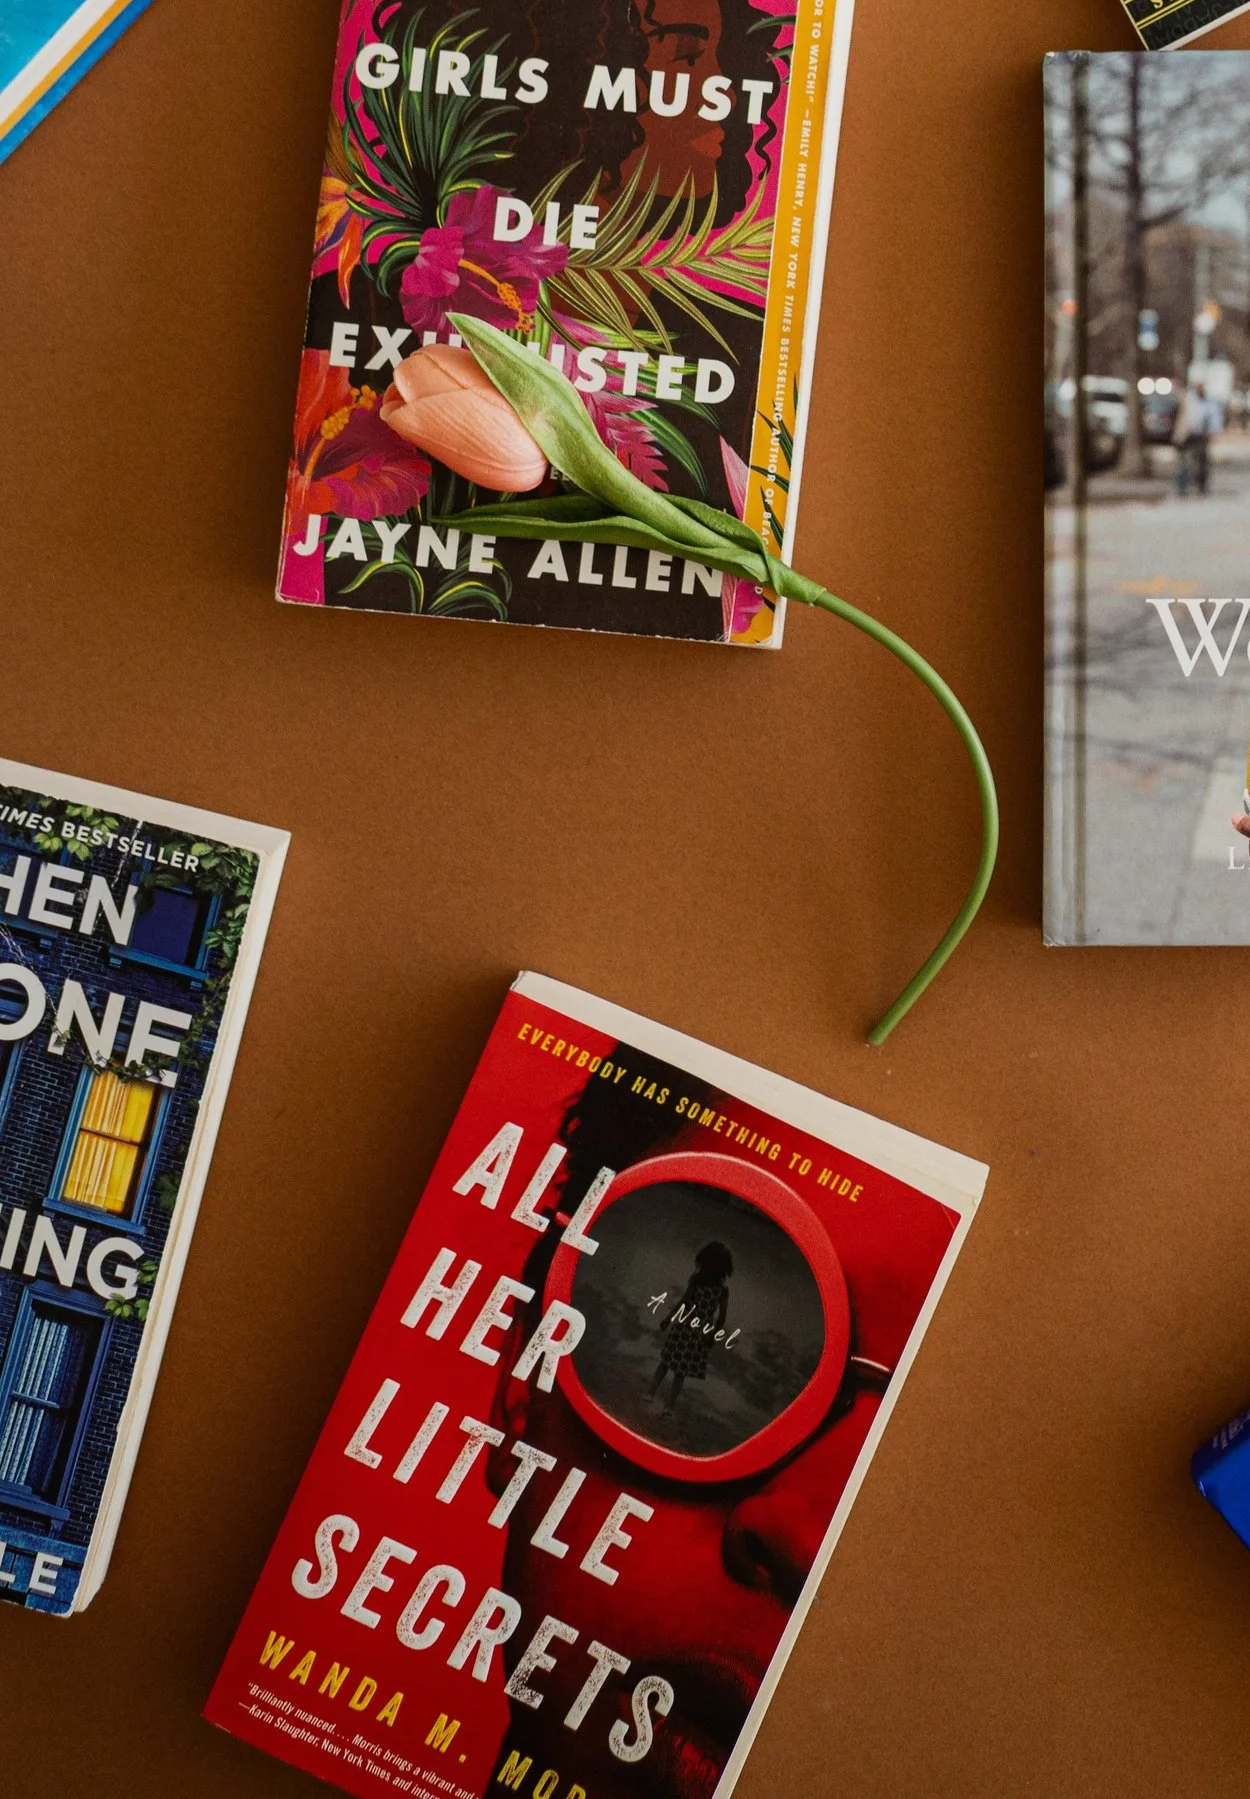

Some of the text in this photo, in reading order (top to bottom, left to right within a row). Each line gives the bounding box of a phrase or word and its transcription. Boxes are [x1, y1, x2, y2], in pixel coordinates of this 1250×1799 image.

[810, 21, 824, 41] TO
[354, 41, 774, 126] GIRLS MUST
[491, 195, 602, 252] DIE
[329, 321, 736, 404] EXSTED
[291, 513, 728, 598] JAYNE ALLEN
[0, 805, 200, 873] IMES BESTSELLER
[515, 1021, 865, 1204] EVERYBODY HAS SOMETHING TO HIDE
[451, 1121, 617, 1255] ALL
[399, 1247, 587, 1394] HER
[645, 1290, 743, 1351] A Novel
[343, 1377, 655, 1587] LITTLE
[291, 1513, 675, 1763] SECRETS
[258, 1629, 468, 1765] WANDA M.
[272, 1715, 321, 1748] Slaughter,
[319, 1737, 343, 1758] New
[341, 1746, 365, 1769] York
[363, 1757, 393, 1783] Times
[390, 1775, 414, 1793] and
